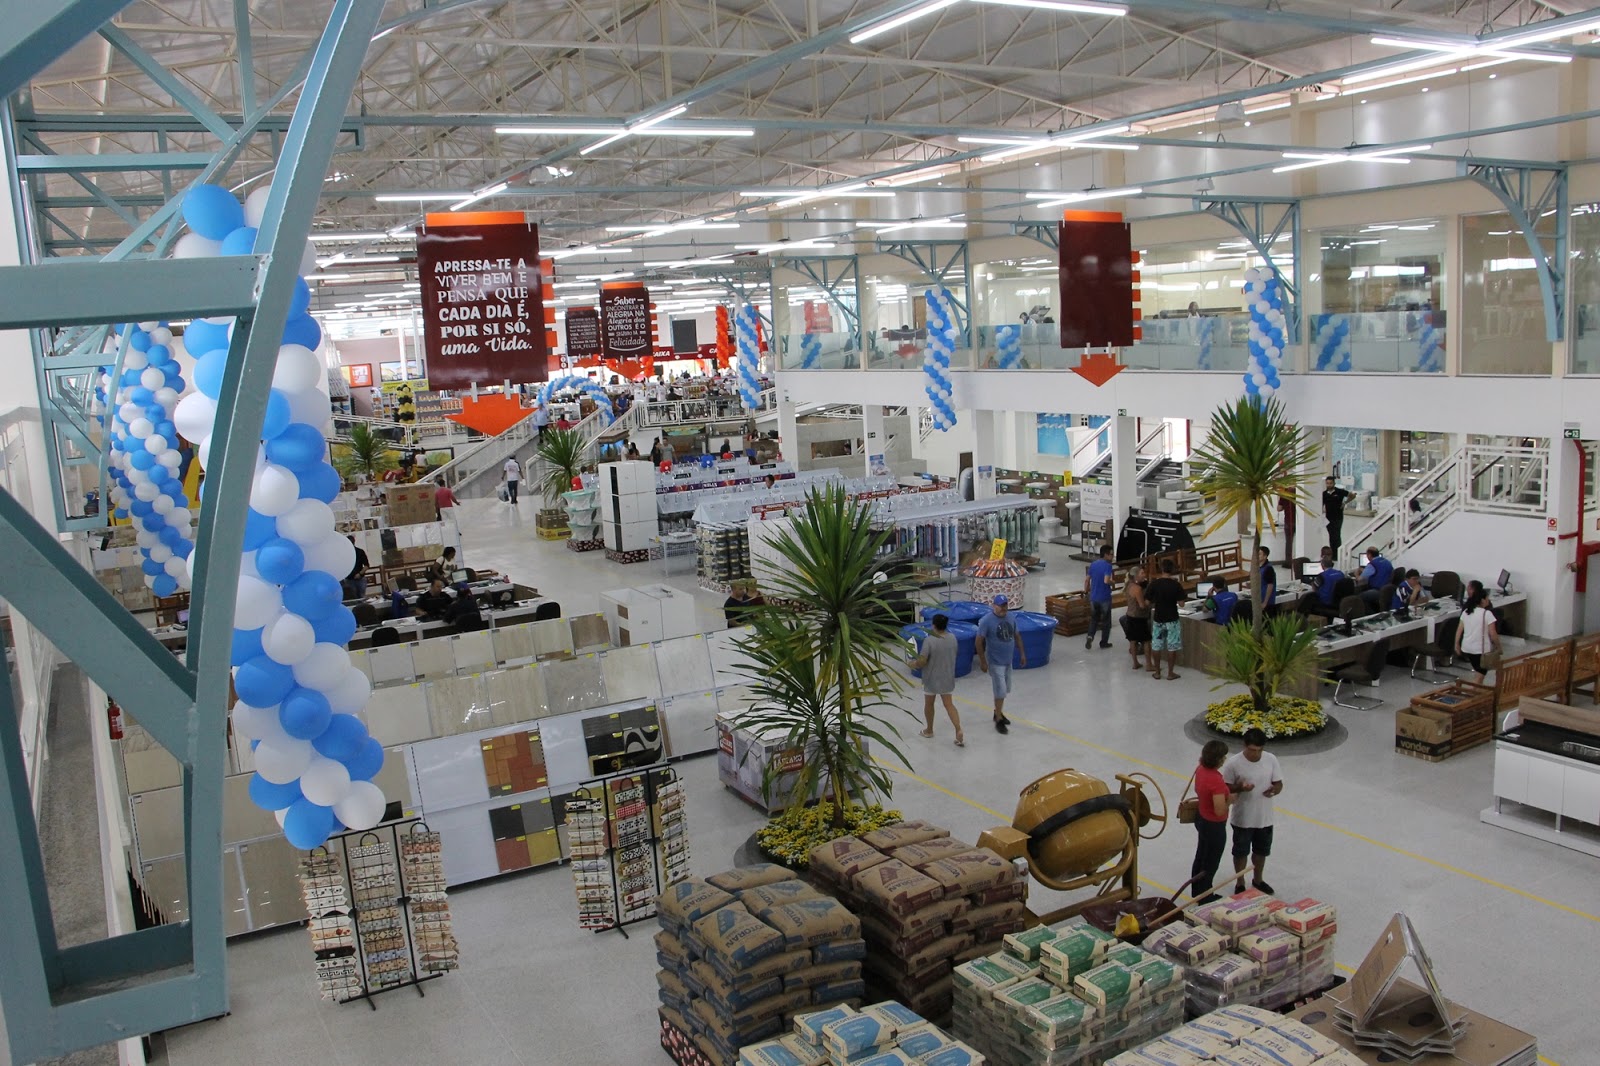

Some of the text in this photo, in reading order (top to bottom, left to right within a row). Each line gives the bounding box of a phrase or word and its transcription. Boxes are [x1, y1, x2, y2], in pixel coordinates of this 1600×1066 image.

[434, 258, 526, 273] APRESSA-TE A
[435, 271, 527, 288] VIVER BEM E
[437, 286, 529, 303] PENSA QUE
[613, 296, 636, 306] Saber
[439, 299, 530, 322] CADA DIA É,
[606, 311, 634, 319] ALEGRIA
[440, 318, 531, 339] POR SI SÓ,
[441, 335, 533, 356] uma Vida.
[1400, 740, 1431, 753] vonder
